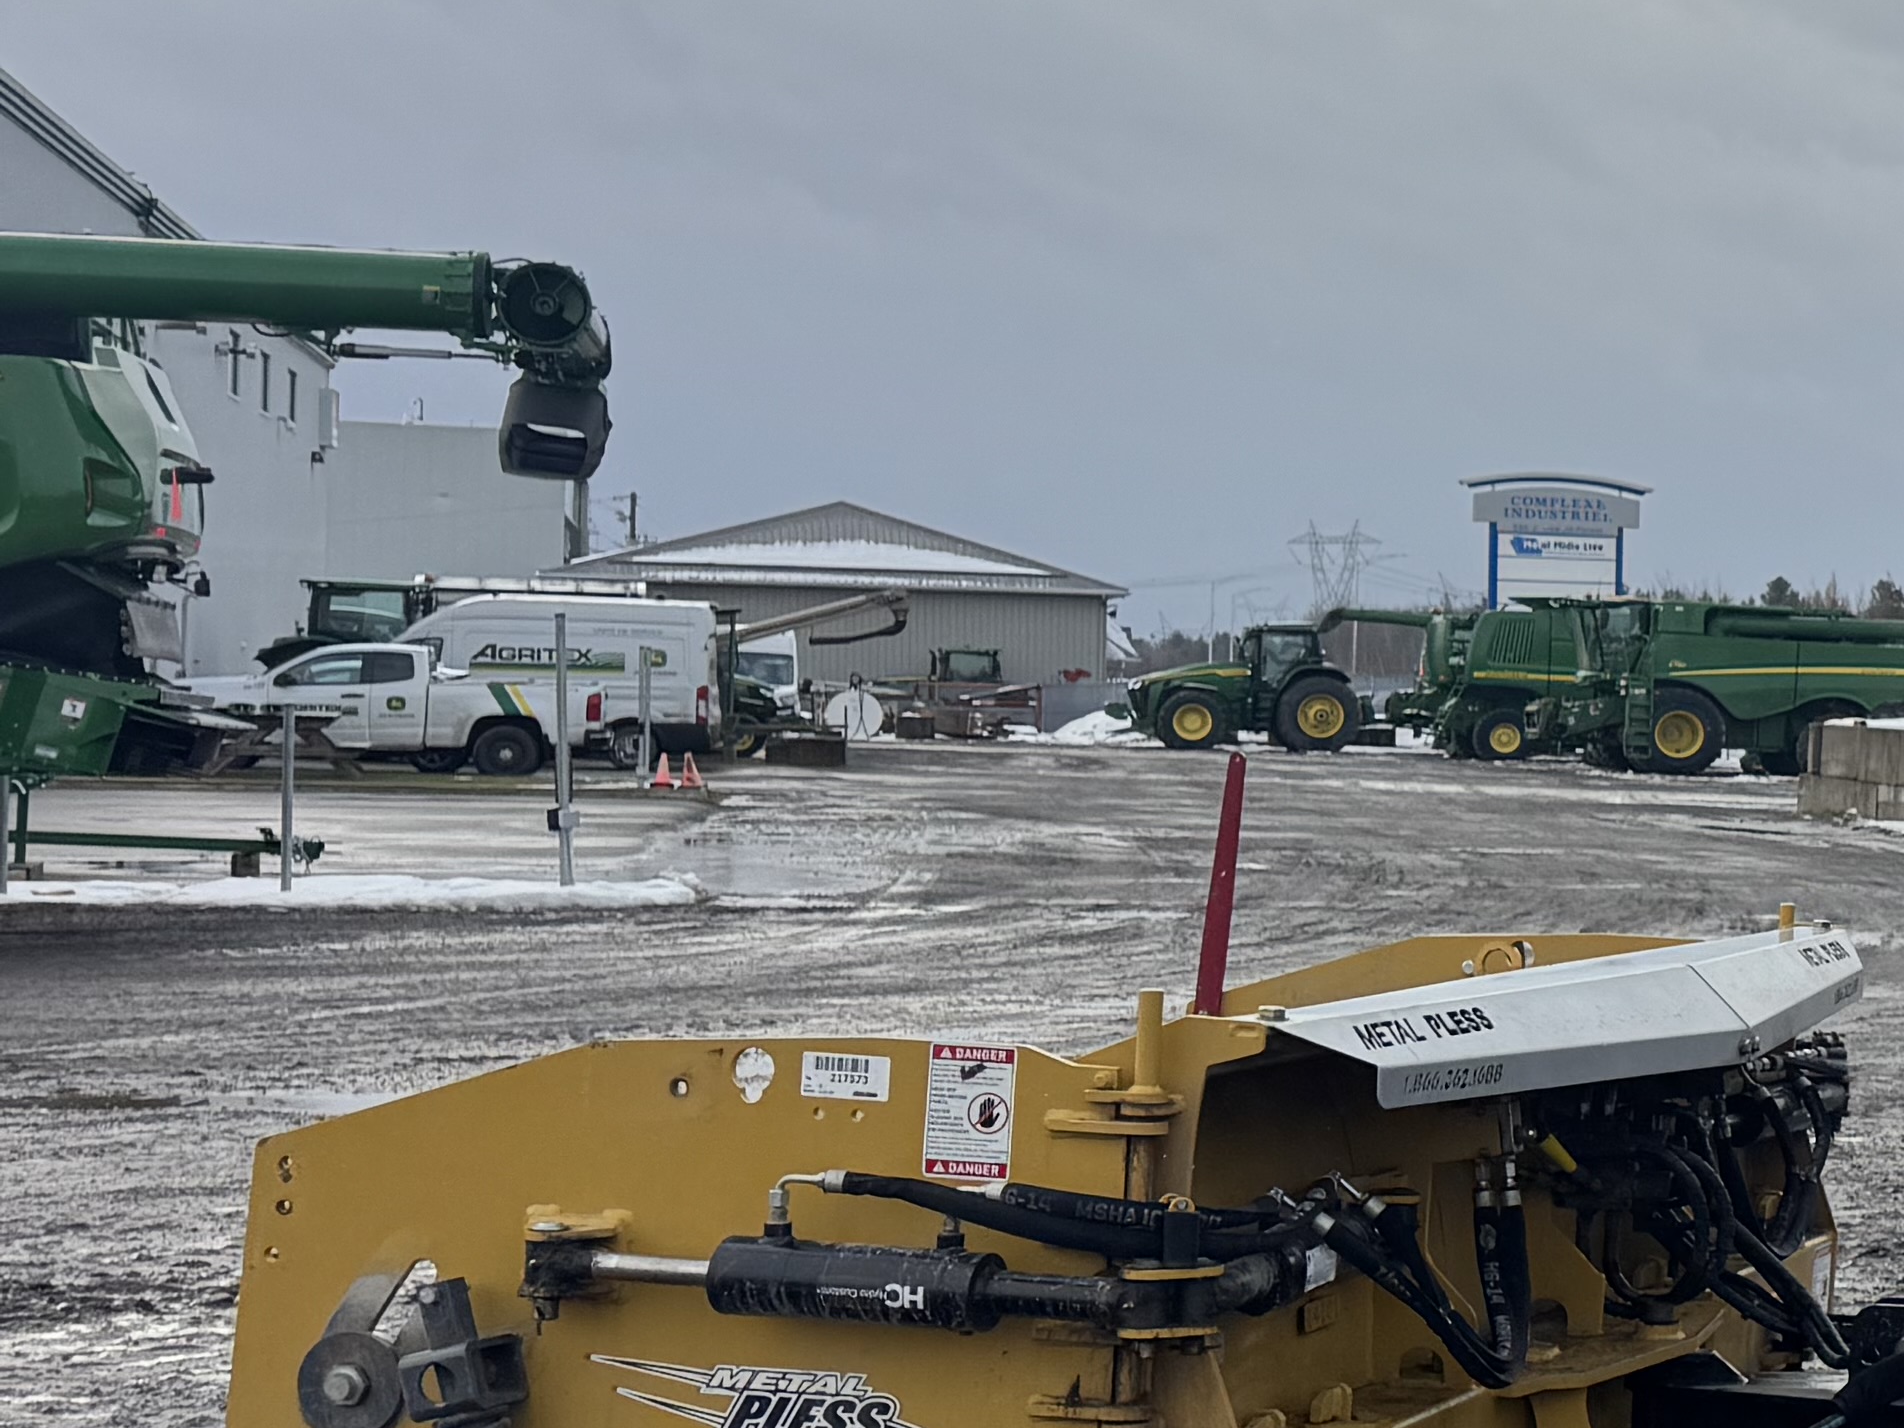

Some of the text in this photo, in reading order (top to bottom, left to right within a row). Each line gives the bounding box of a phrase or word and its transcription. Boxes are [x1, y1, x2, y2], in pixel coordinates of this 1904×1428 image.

[1510, 496, 1607, 511] COMPLEXE
[1504, 507, 1613, 523] INDUSTRIEL
[1352, 1007, 1495, 1051] METAL PLESS
[955, 1047, 1007, 1062] DANGER
[948, 1162, 1000, 1177] DANGER
[884, 1283, 924, 1310] HC
[708, 1368, 866, 1396] METAL
